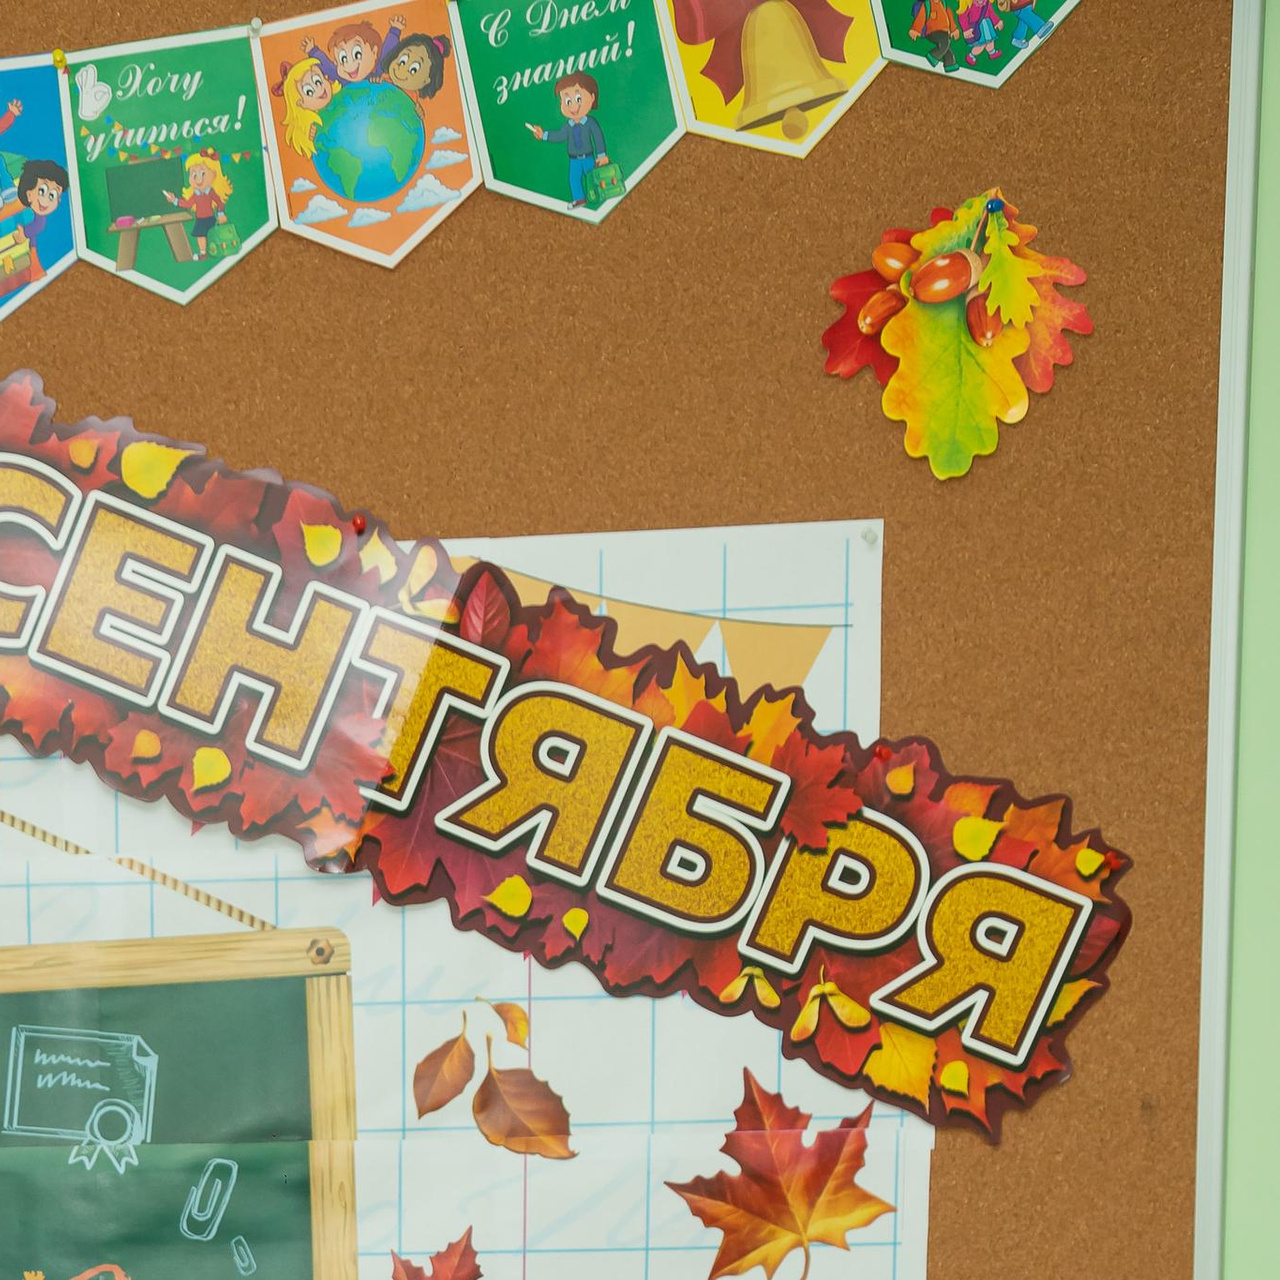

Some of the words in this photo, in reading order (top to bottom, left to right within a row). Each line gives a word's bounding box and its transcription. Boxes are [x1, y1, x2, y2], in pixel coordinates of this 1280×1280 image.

[480, 9, 512, 48] С
[116, 62, 205, 101] Хочу
[492, 20, 636, 105] знаний!
[84, 95, 247, 163] учиться!
